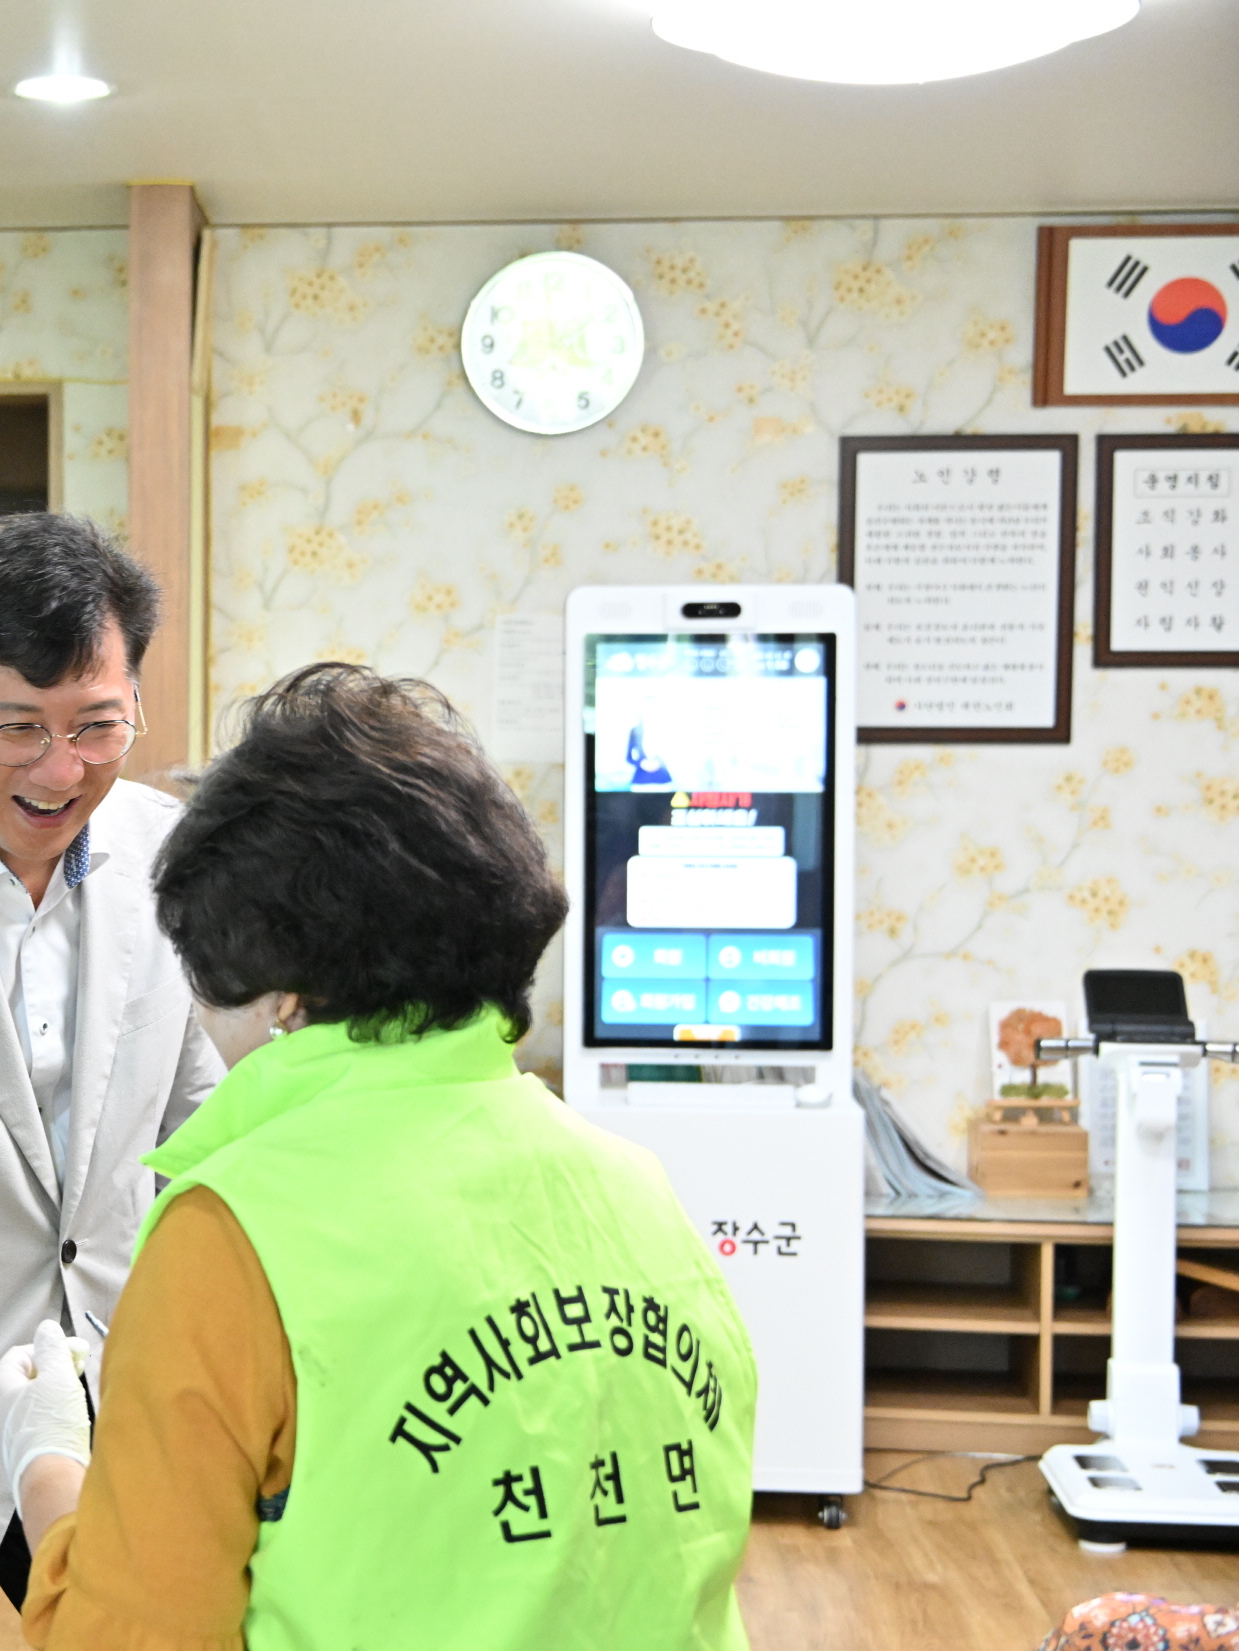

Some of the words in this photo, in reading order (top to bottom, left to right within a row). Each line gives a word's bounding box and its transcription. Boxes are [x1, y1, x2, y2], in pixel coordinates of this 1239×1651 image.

[481, 334, 495, 355] 9
[490, 369, 505, 390] 8
[512, 389, 526, 411] 7
[577, 391, 590, 411] 5
[711, 1220, 802, 1257] 장수군
[389, 1285, 724, 1474] 지역사회보장협의체
[491, 1439, 701, 1544] 천천면
